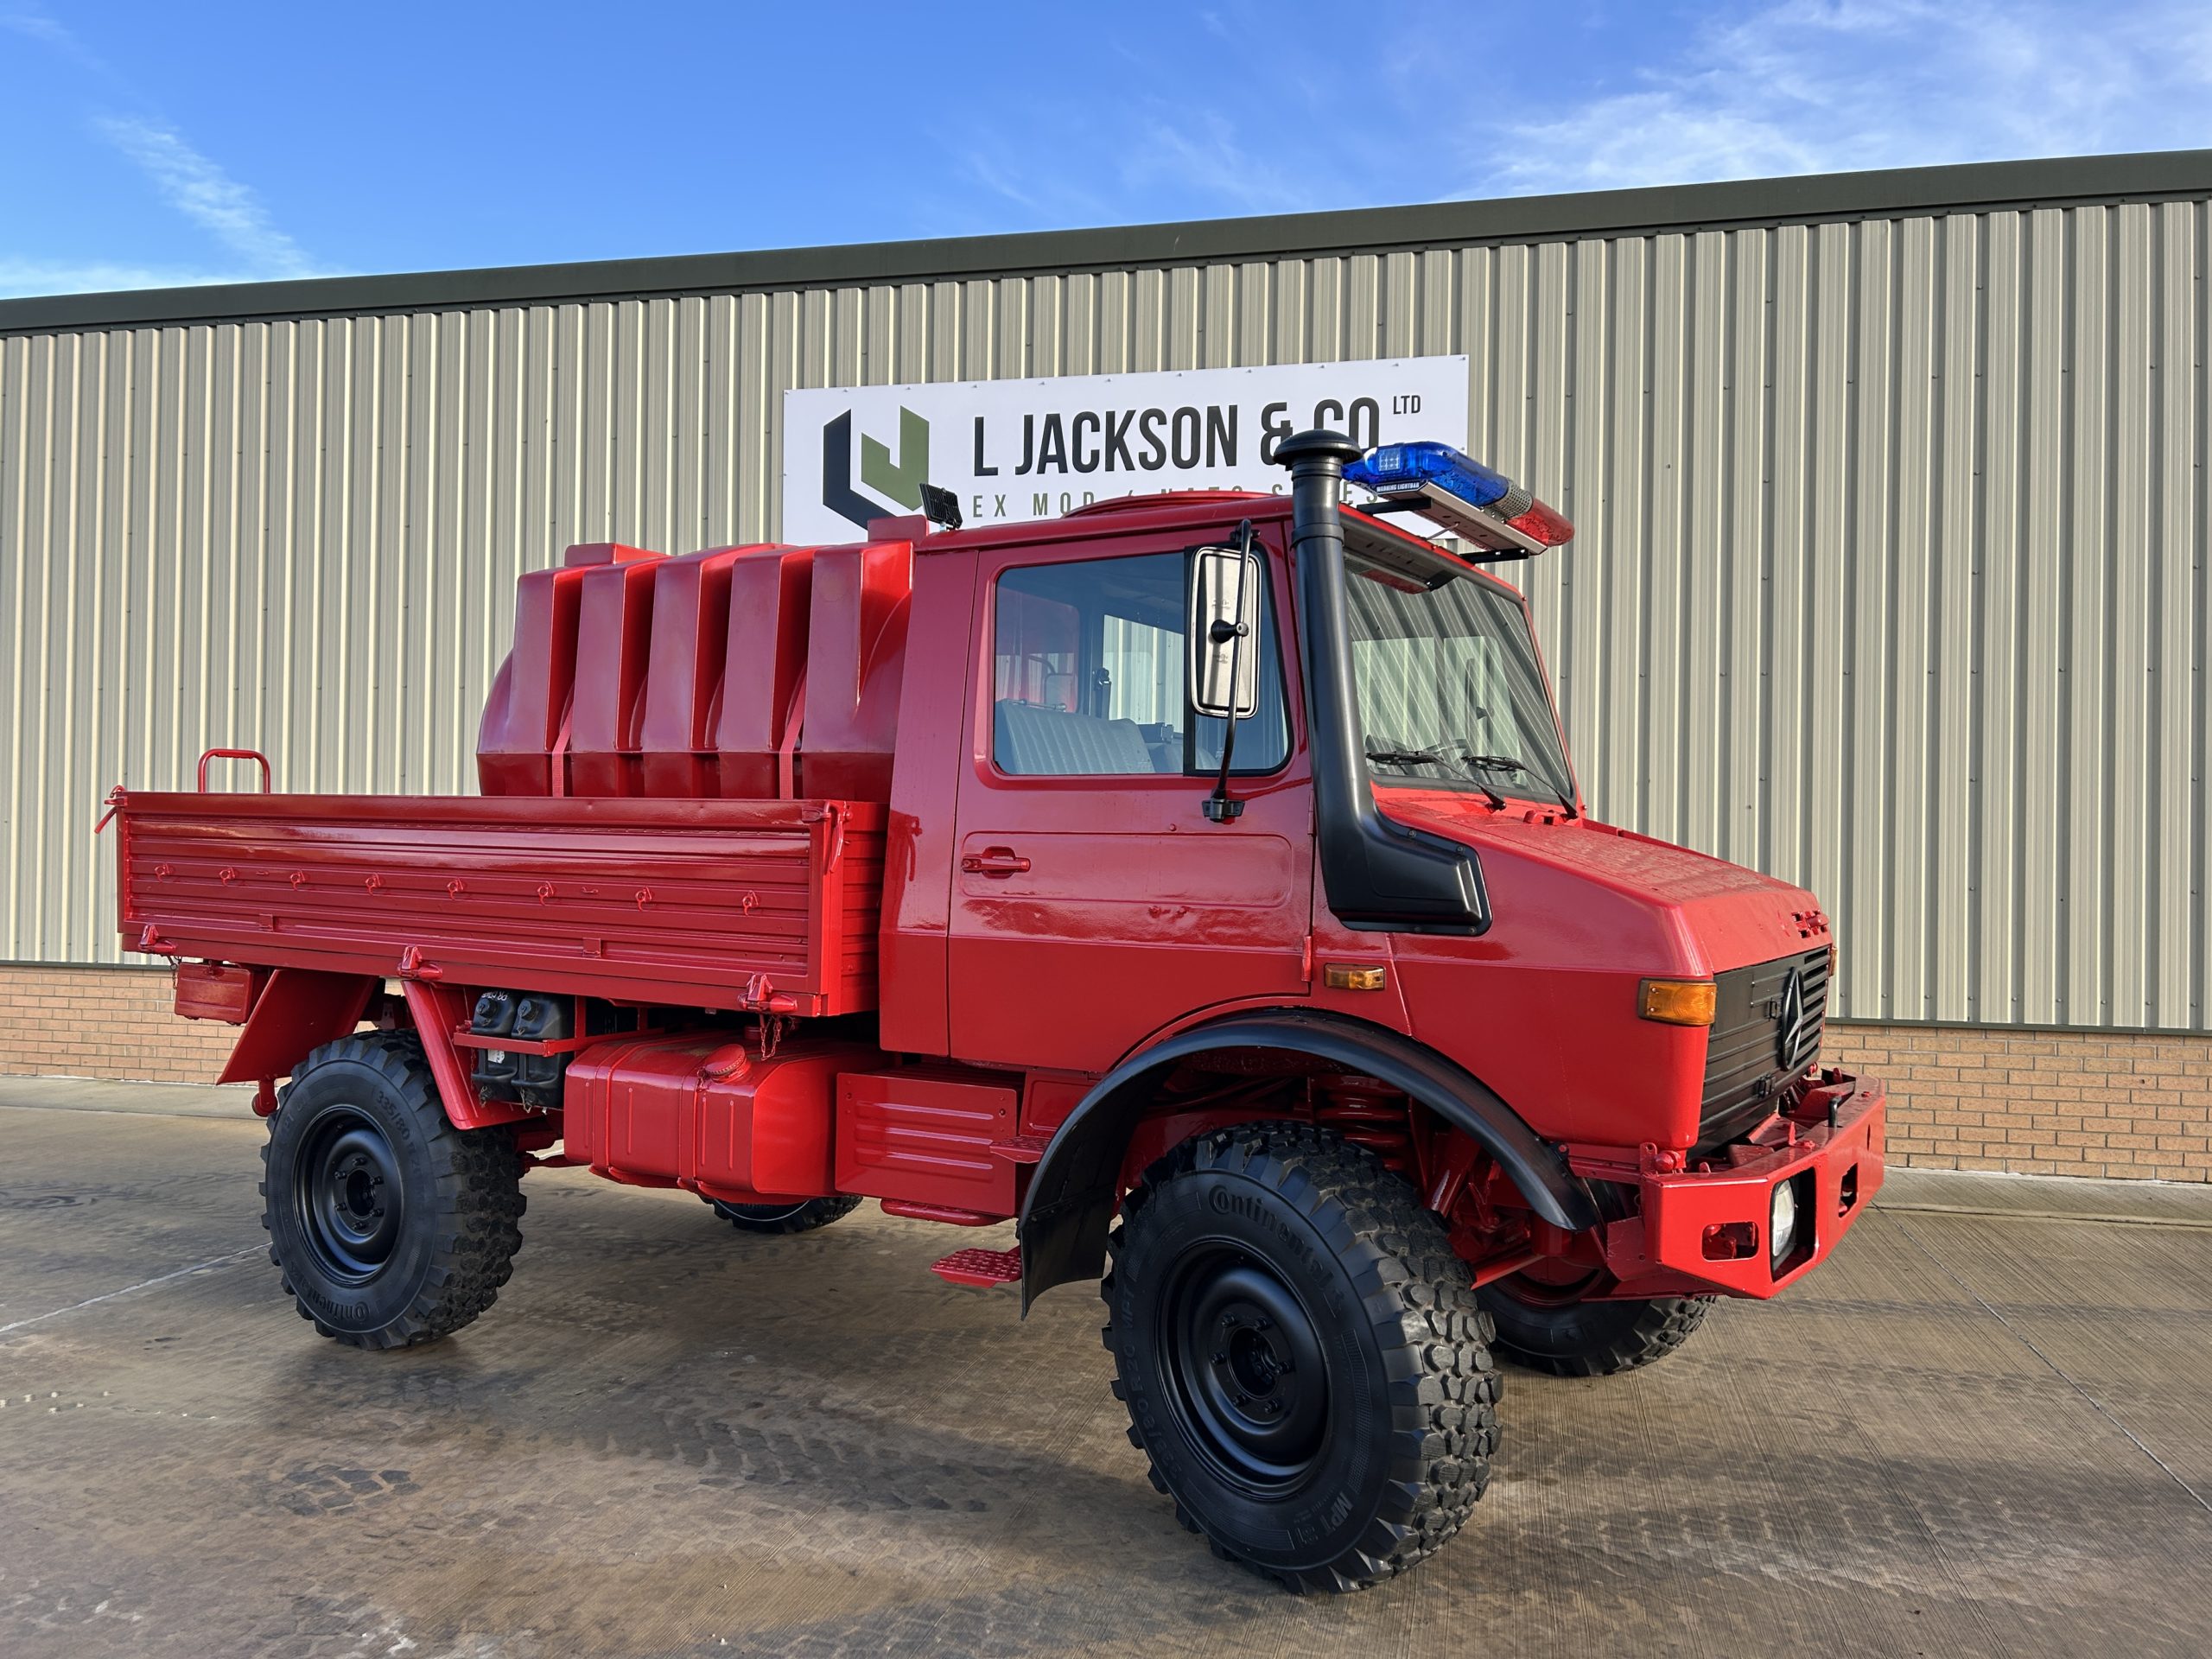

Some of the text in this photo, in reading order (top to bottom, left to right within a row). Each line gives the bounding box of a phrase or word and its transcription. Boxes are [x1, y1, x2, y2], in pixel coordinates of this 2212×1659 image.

[974, 416, 999, 476] L
[1014, 404, 1238, 475] JACKSON
[1260, 401, 1294, 466] &
[1392, 394, 1421, 415] LTD
[973, 493, 1007, 518] EX
[1033, 491, 1095, 516] MOD
[376, 1090, 410, 1141] 335/80
[1209, 1185, 1336, 1291] Continental
[1319, 1491, 1355, 1537] MPT
